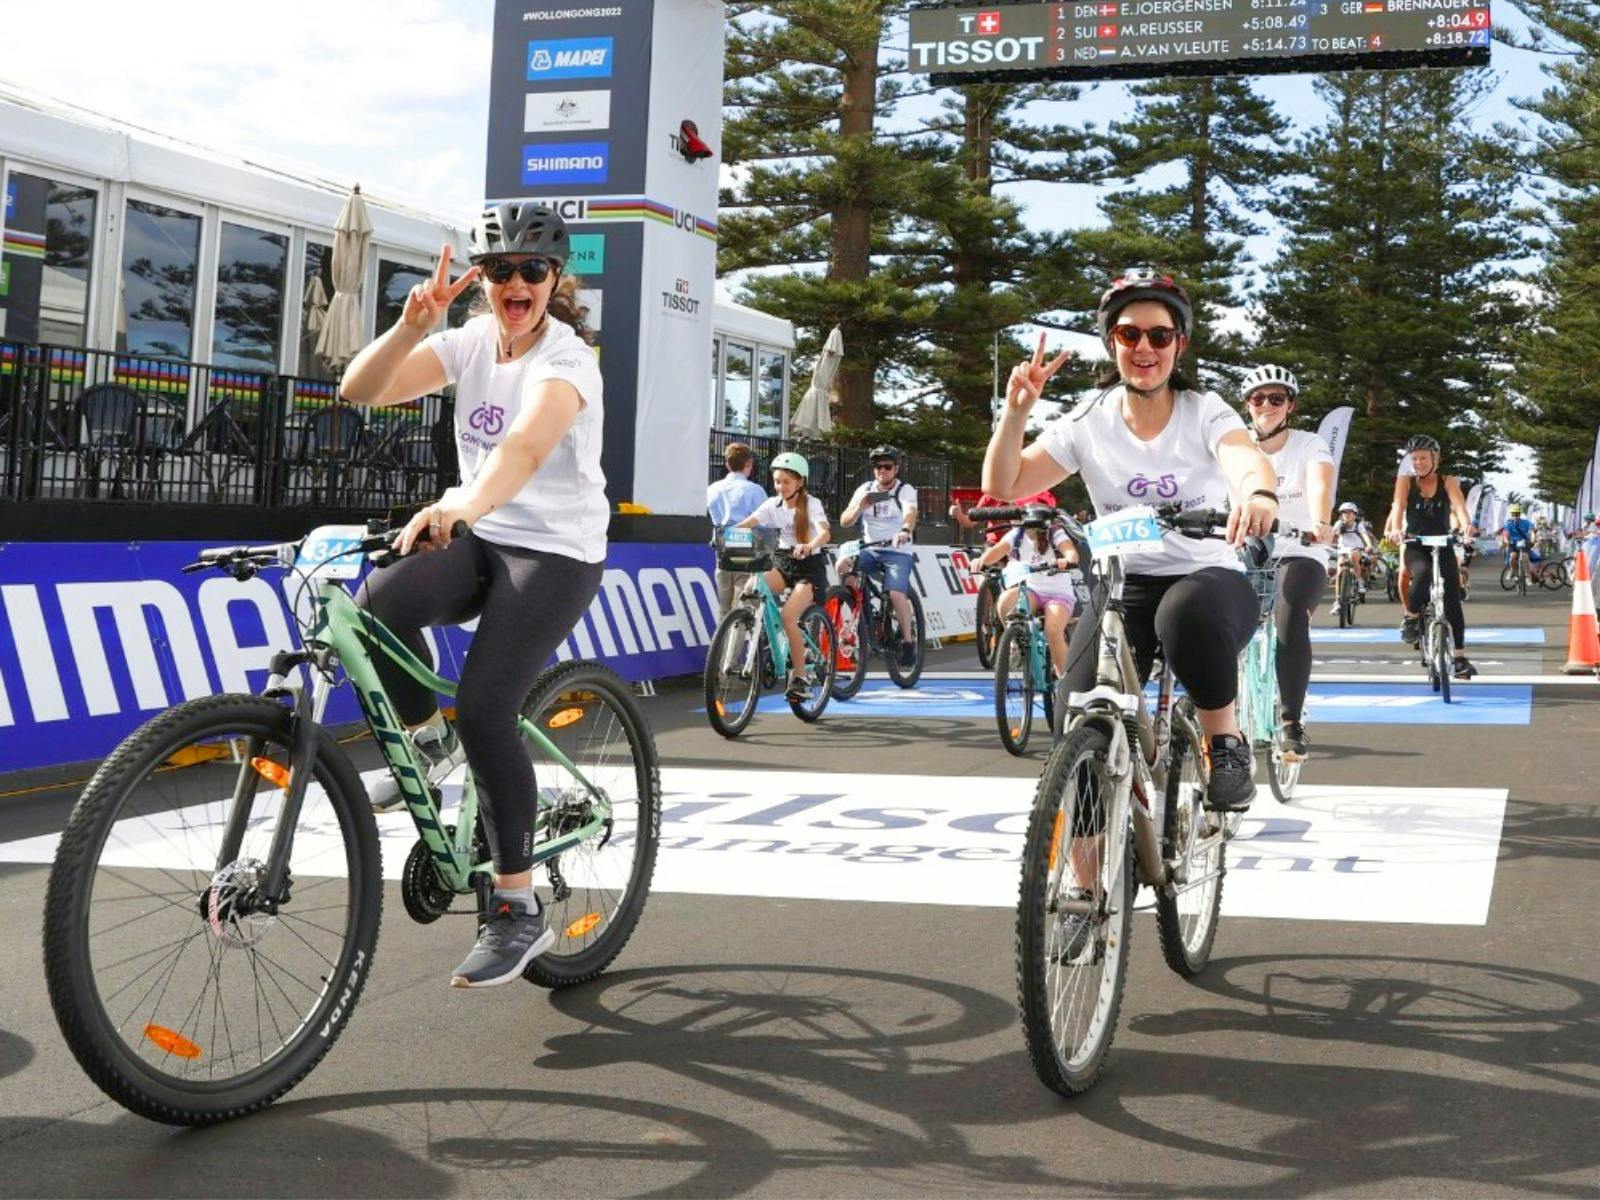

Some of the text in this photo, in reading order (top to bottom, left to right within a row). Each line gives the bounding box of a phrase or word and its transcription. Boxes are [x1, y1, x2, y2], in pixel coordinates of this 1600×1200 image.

[522, 7, 622, 20] #WOLLONGONG2022
[1057, 7, 1065, 19] 1
[1074, 5, 1098, 18] DEN
[1121, 0, 1233, 15] E.JOERGENSEN
[1320, 5, 1329, 15] 3
[1341, 3, 1363, 14] GER
[1387, 0, 1470, 12] BRENNAUER
[1056, 14, 1307, 40] 2 SUI M.REUSSER +5:08.49
[1427, 13, 1486, 28] +8:04.9
[1311, 36, 1382, 50] TO BEAT: 4
[1425, 30, 1485, 45] +8:18.72
[553, 48, 608, 68] MAPEI
[911, 36, 1045, 67] TISSOT
[1056, 36, 1307, 61] 3 NED A.VAN VLEUTE +5:14.73
[526, 155, 604, 172] SHIMANO
[674, 210, 696, 234] UCI
[661, 291, 700, 315] TISSOT
[1099, 519, 1150, 542] 4176
[367, 689, 460, 874] SCOTT
